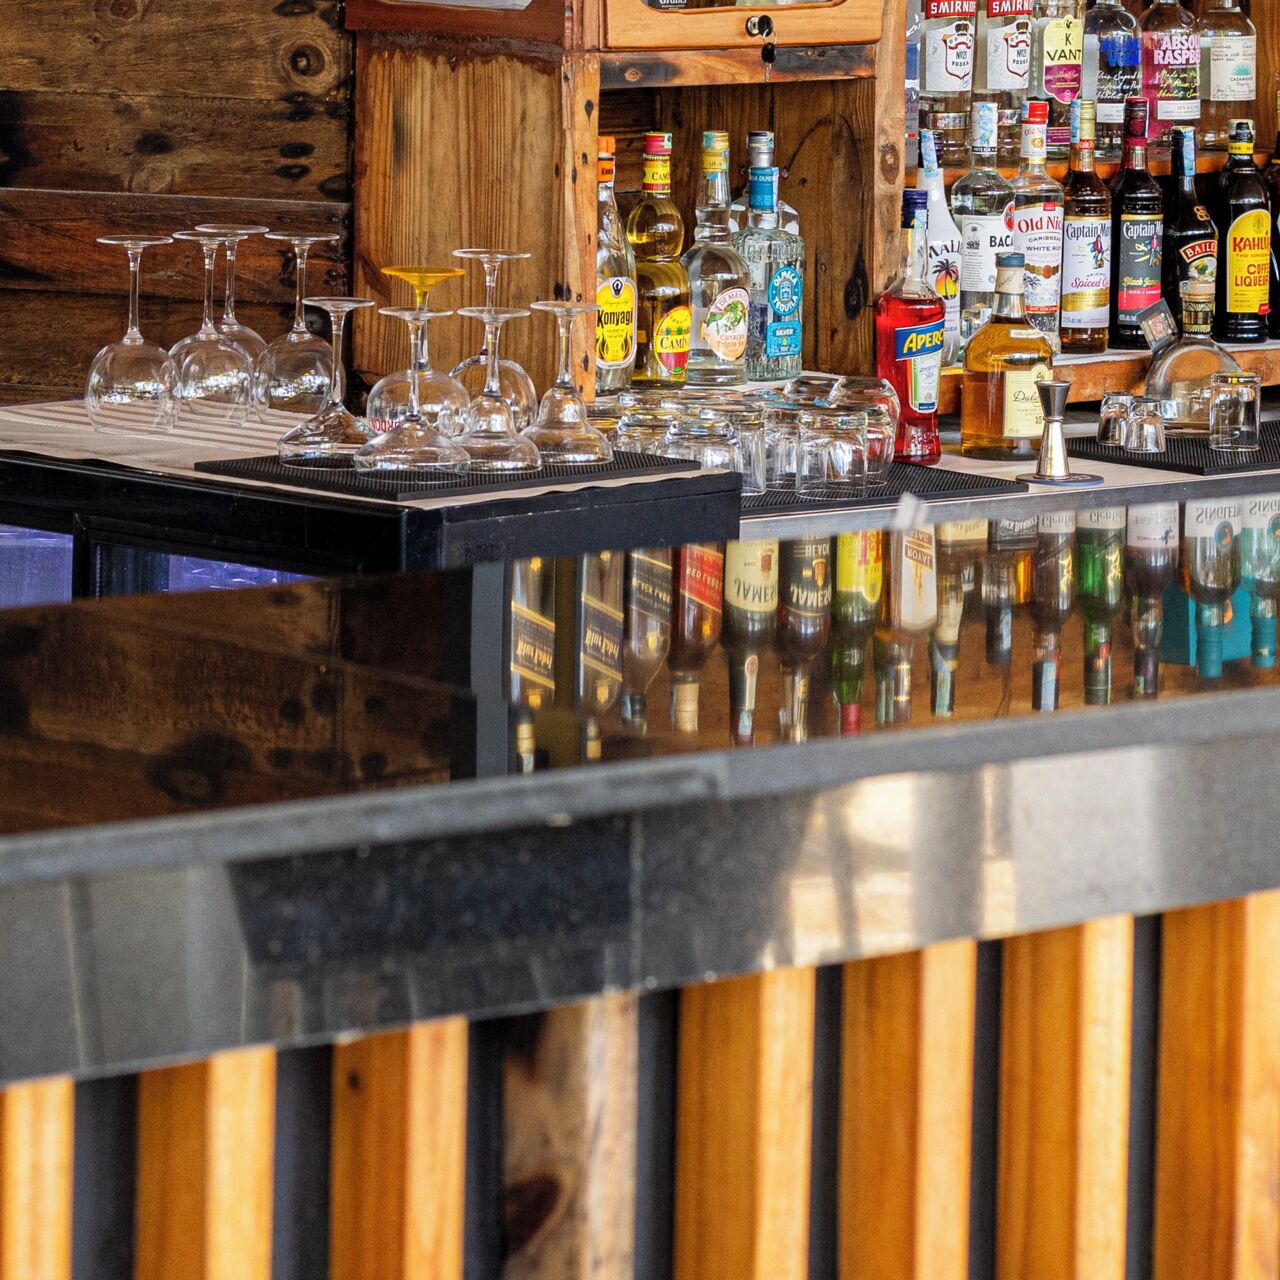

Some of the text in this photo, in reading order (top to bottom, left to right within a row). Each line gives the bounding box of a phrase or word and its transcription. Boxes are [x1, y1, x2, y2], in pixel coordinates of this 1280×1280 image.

[1046, 49, 1081, 61] VANT
[1018, 217, 1045, 234] Old
[1066, 223, 1098, 241] Captain
[1123, 222, 1155, 239] Captain
[773, 267, 798, 287] OLMECA
[1071, 277, 1102, 288] Spiced
[773, 295, 798, 314] TEQUILA
[597, 308, 633, 328] Konyagi
